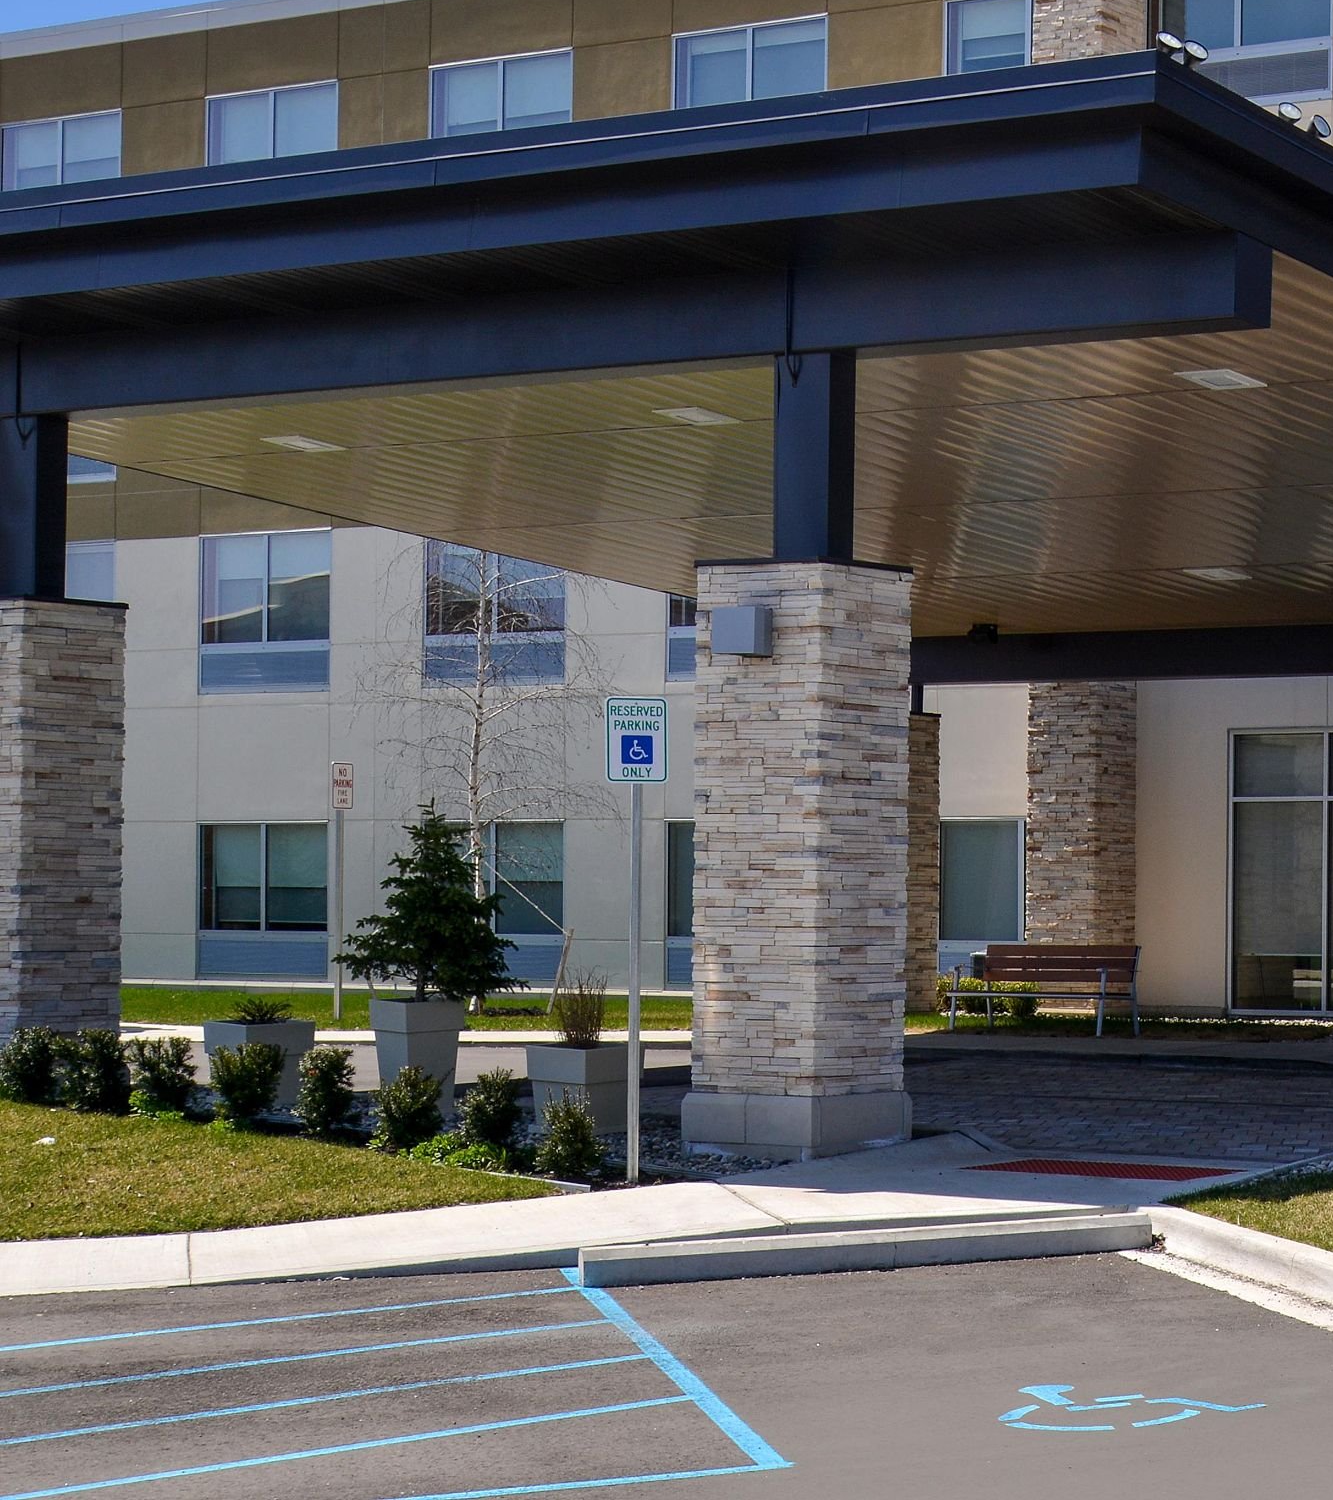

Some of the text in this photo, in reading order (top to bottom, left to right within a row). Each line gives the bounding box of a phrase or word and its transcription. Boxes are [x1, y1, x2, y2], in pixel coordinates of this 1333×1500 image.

[610, 705, 663, 717] RESERVED
[614, 720, 660, 732] PARKING
[338, 768, 347, 778] NO
[622, 767, 652, 778] ONLY
[333, 779, 353, 788] PARKING
[337, 789, 348, 797] FIRE
